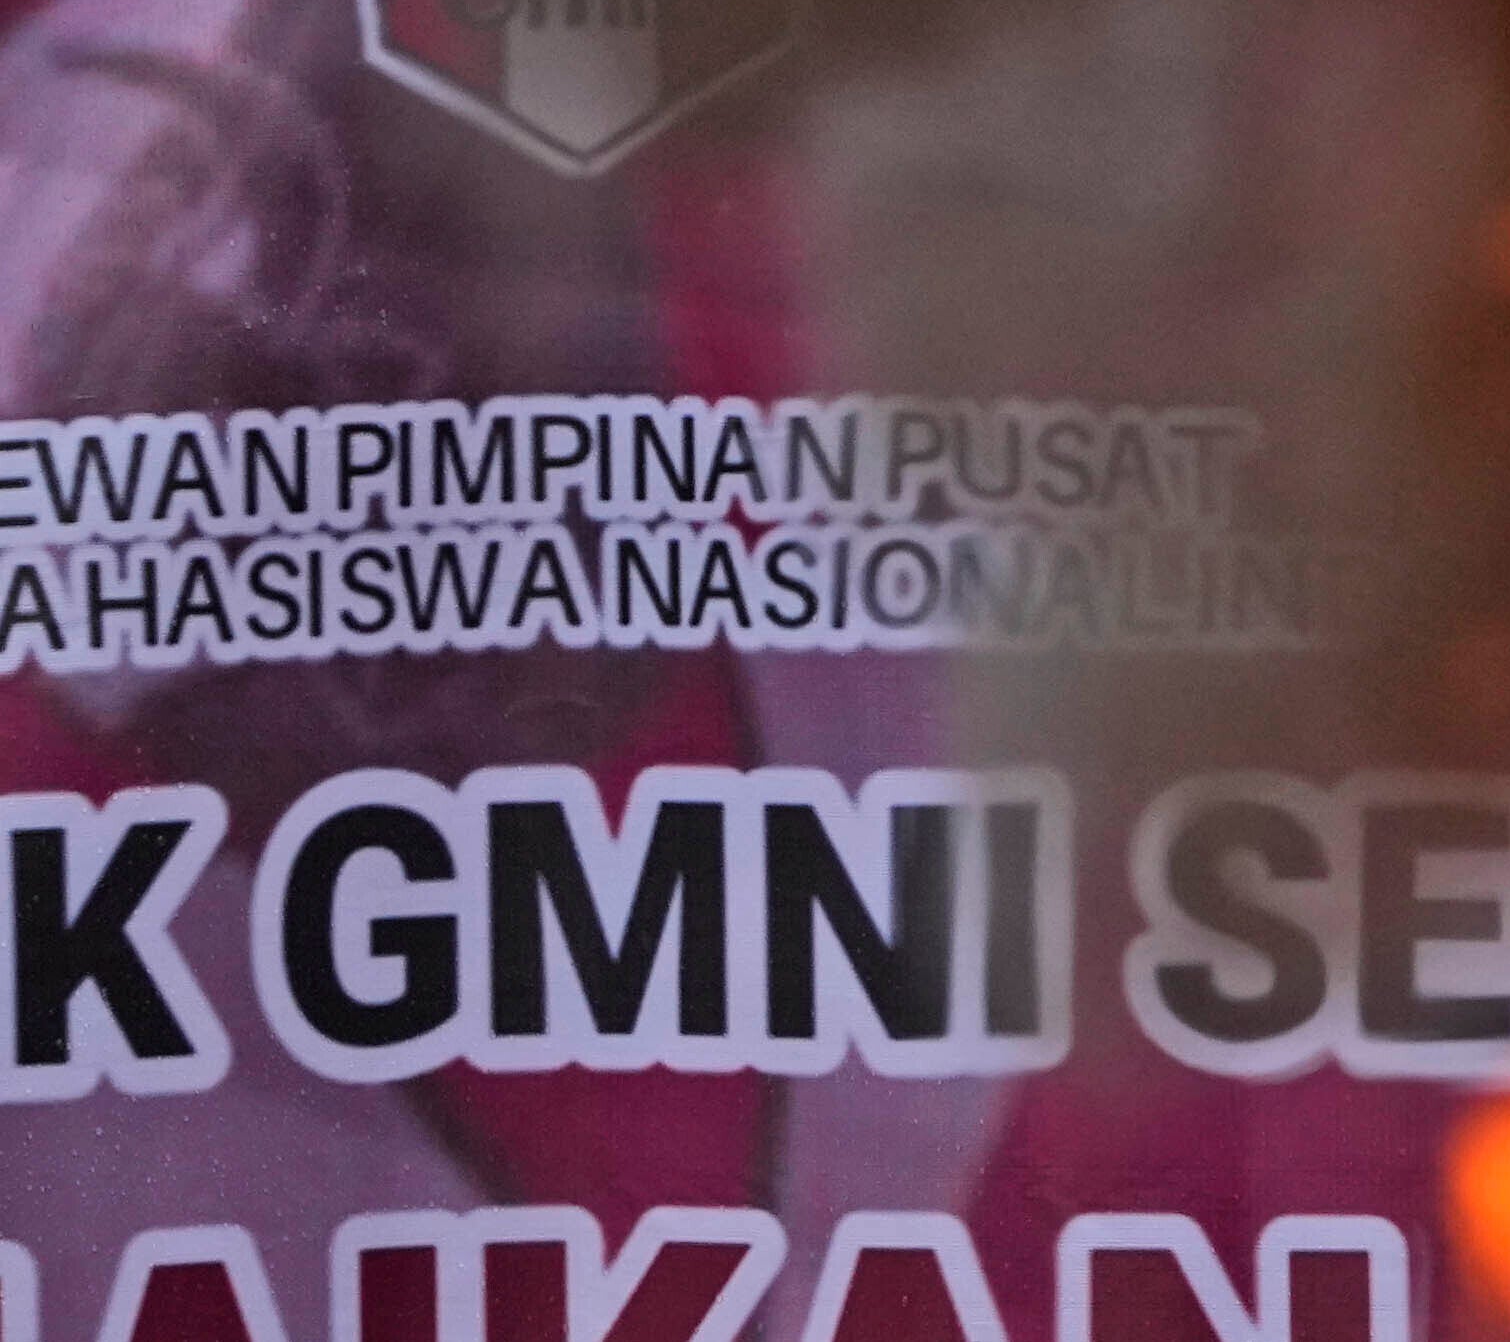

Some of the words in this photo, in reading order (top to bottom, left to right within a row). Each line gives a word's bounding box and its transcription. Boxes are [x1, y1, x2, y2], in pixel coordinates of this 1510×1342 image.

[338, 410, 855, 515] PIMPINAN
[887, 410, 1237, 518] PUSAT
[281, 800, 1039, 1050] GMNI
